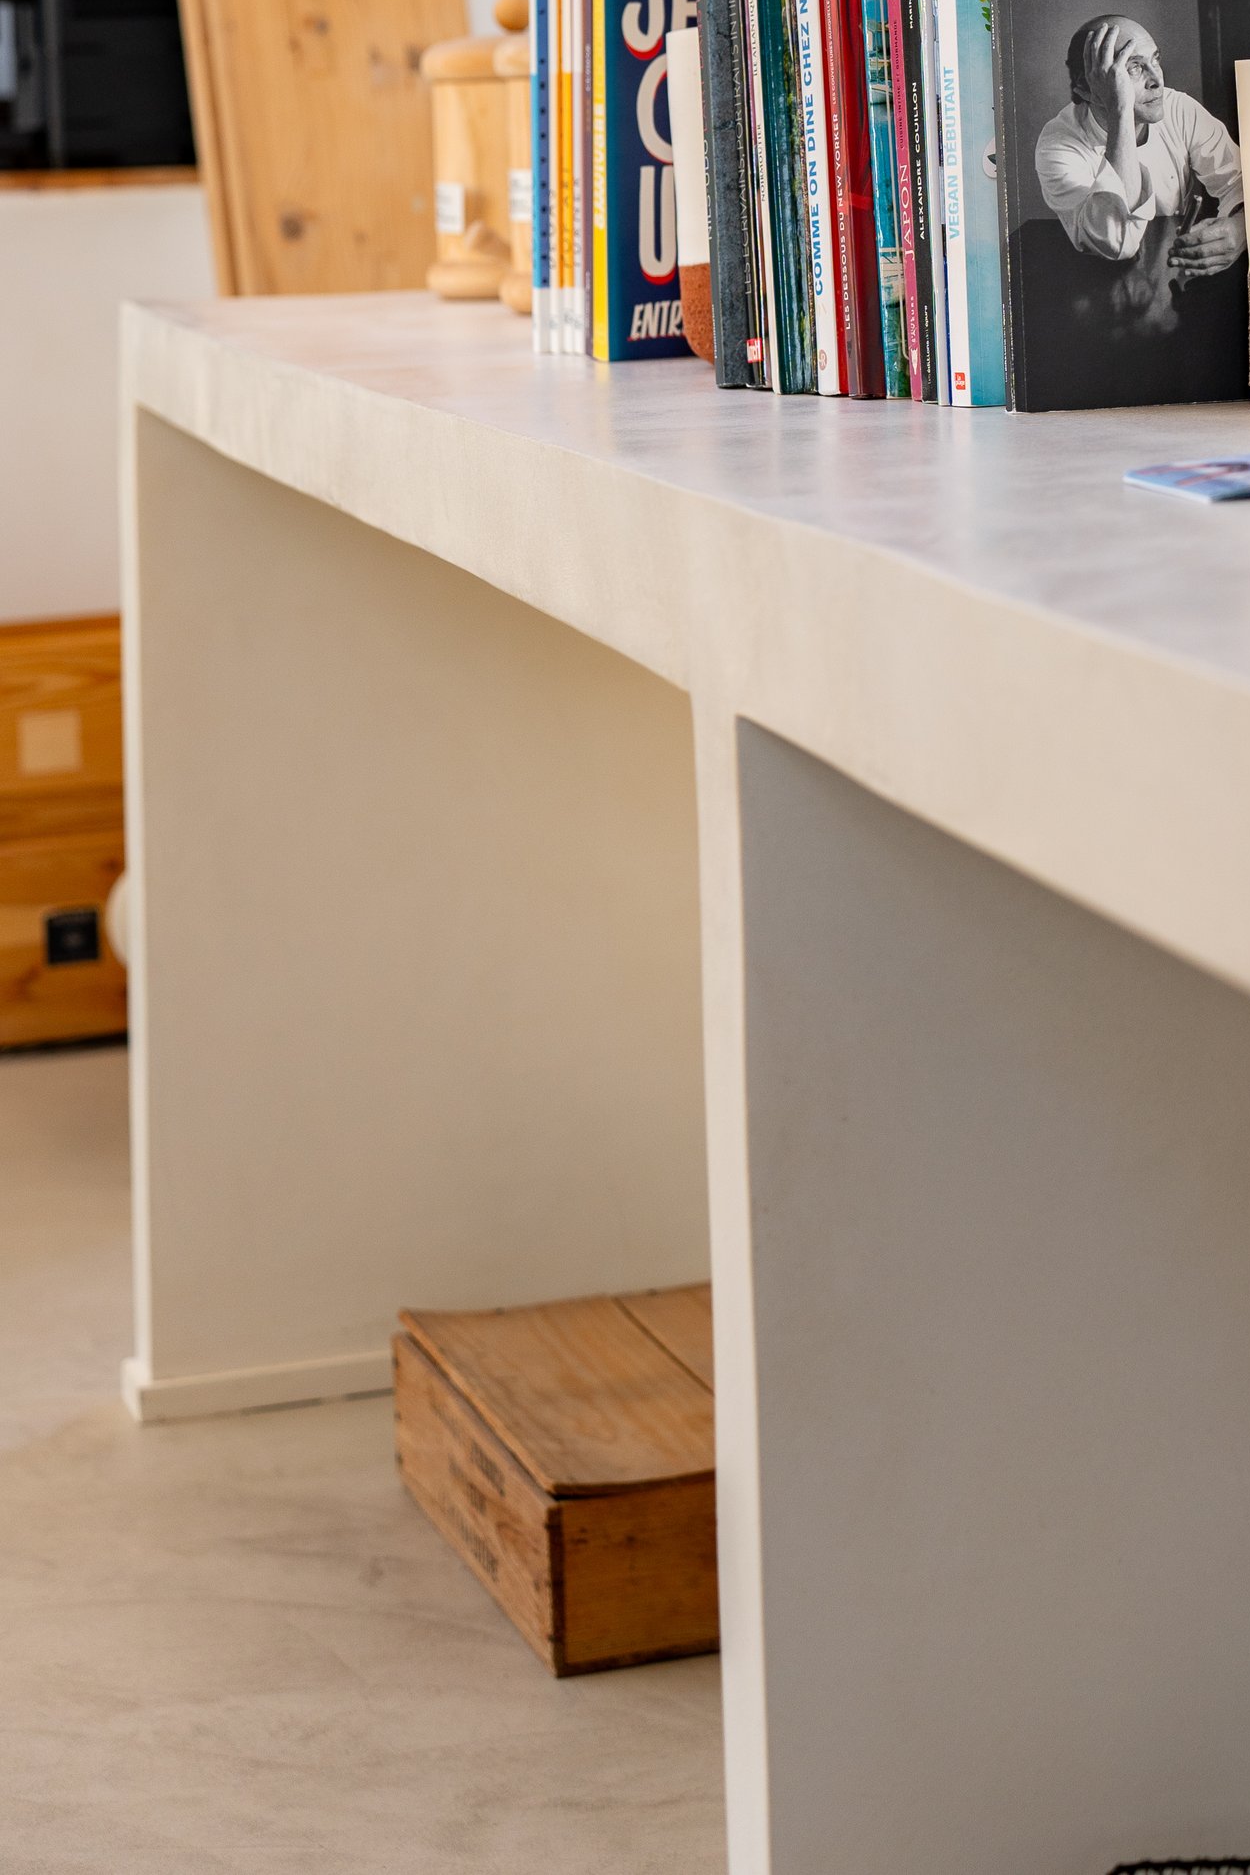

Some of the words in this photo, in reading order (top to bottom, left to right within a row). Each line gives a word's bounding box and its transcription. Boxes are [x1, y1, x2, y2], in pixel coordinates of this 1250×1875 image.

[799, 22, 813, 86] CHEZ
[829, 40, 837, 94] COUVERTURES
[892, 19, 901, 70] GOURMANDE
[730, 43, 744, 151] PORTRAITS
[802, 94, 816, 152] DÎNE
[895, 85, 903, 113] INTIME
[911, 82, 921, 153] COUILLON
[942, 67, 958, 166] DÉBUTANT
[756, 123, 765, 202] NOIRMOUTIER
[833, 113, 842, 170] YORKER
[805, 159, 818, 196] ON
[835, 175, 844, 207] NEW
[915, 158, 926, 240] ALEXANDRE
[838, 211, 846, 230] DU
[900, 163, 915, 261] JAPON
[947, 175, 960, 240] VEGAN
[741, 261, 753, 295] LES
[810, 203, 824, 296] COMME
[840, 234, 850, 300] DESSOUS
[630, 299, 684, 341] ENTR
[844, 305, 852, 330] LES
